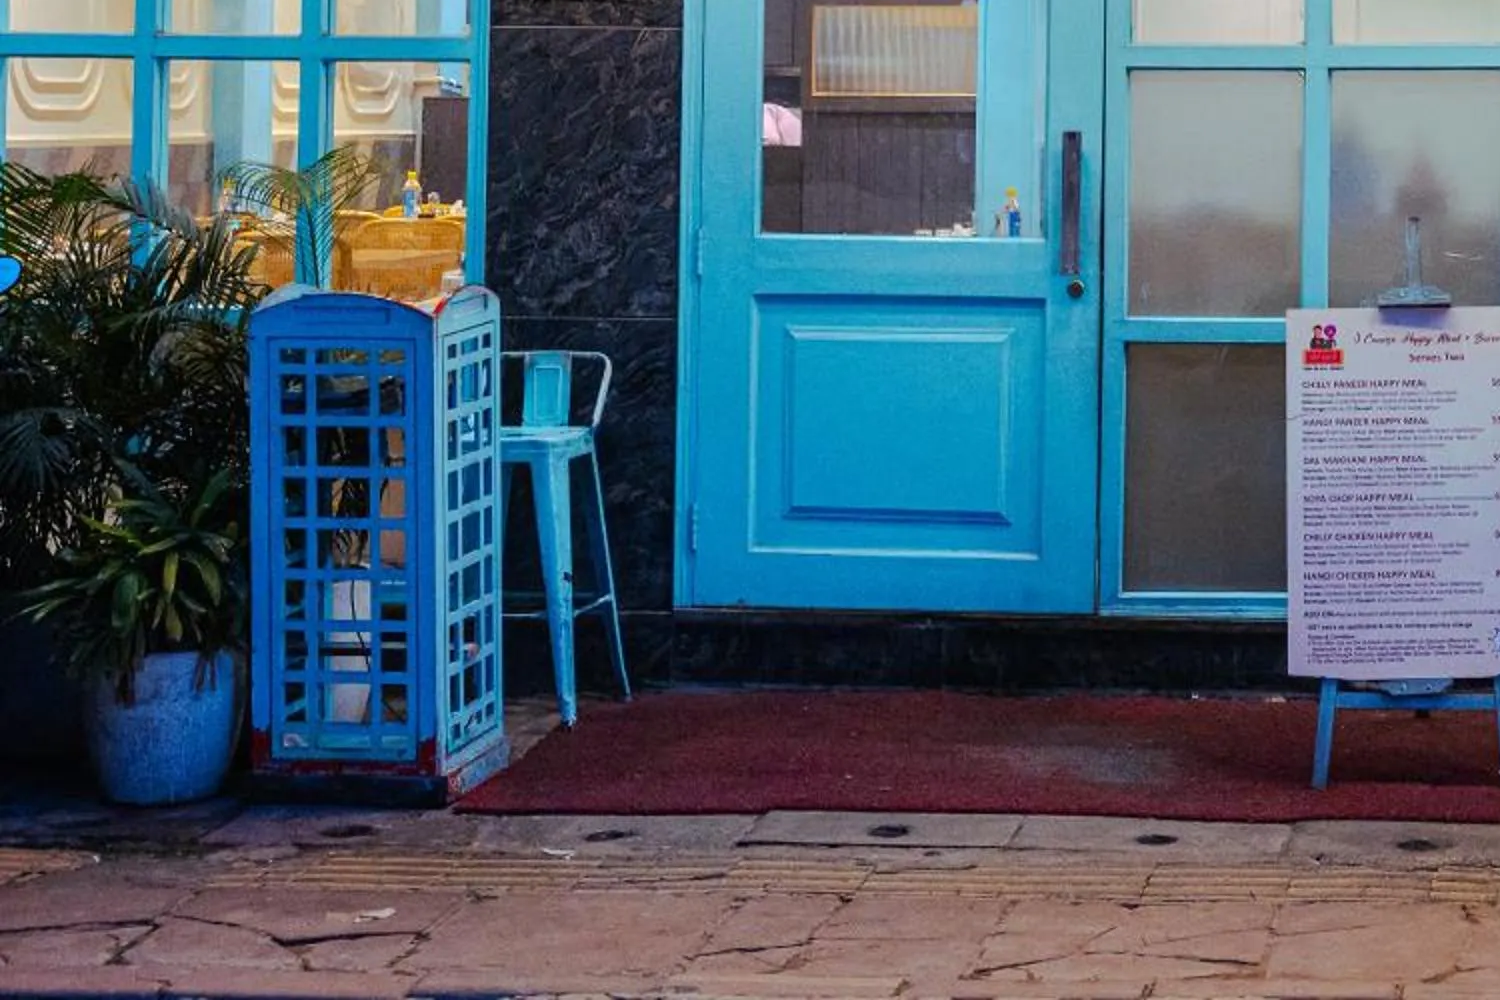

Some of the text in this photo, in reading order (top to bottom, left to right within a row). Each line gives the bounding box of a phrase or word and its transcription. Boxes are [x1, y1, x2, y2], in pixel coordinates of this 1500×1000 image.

[1370, 378, 1400, 388] HAPPY
[1371, 417, 1401, 427] HAPPY
[1370, 456, 1400, 465] HAPPY
[1356, 493, 1386, 502] HAPPY
[1376, 532, 1407, 541] HAPPY
[1409, 531, 1434, 541] MEAL
[1377, 570, 1408, 580] HAPPY
[1409, 569, 1436, 579] MEAL
